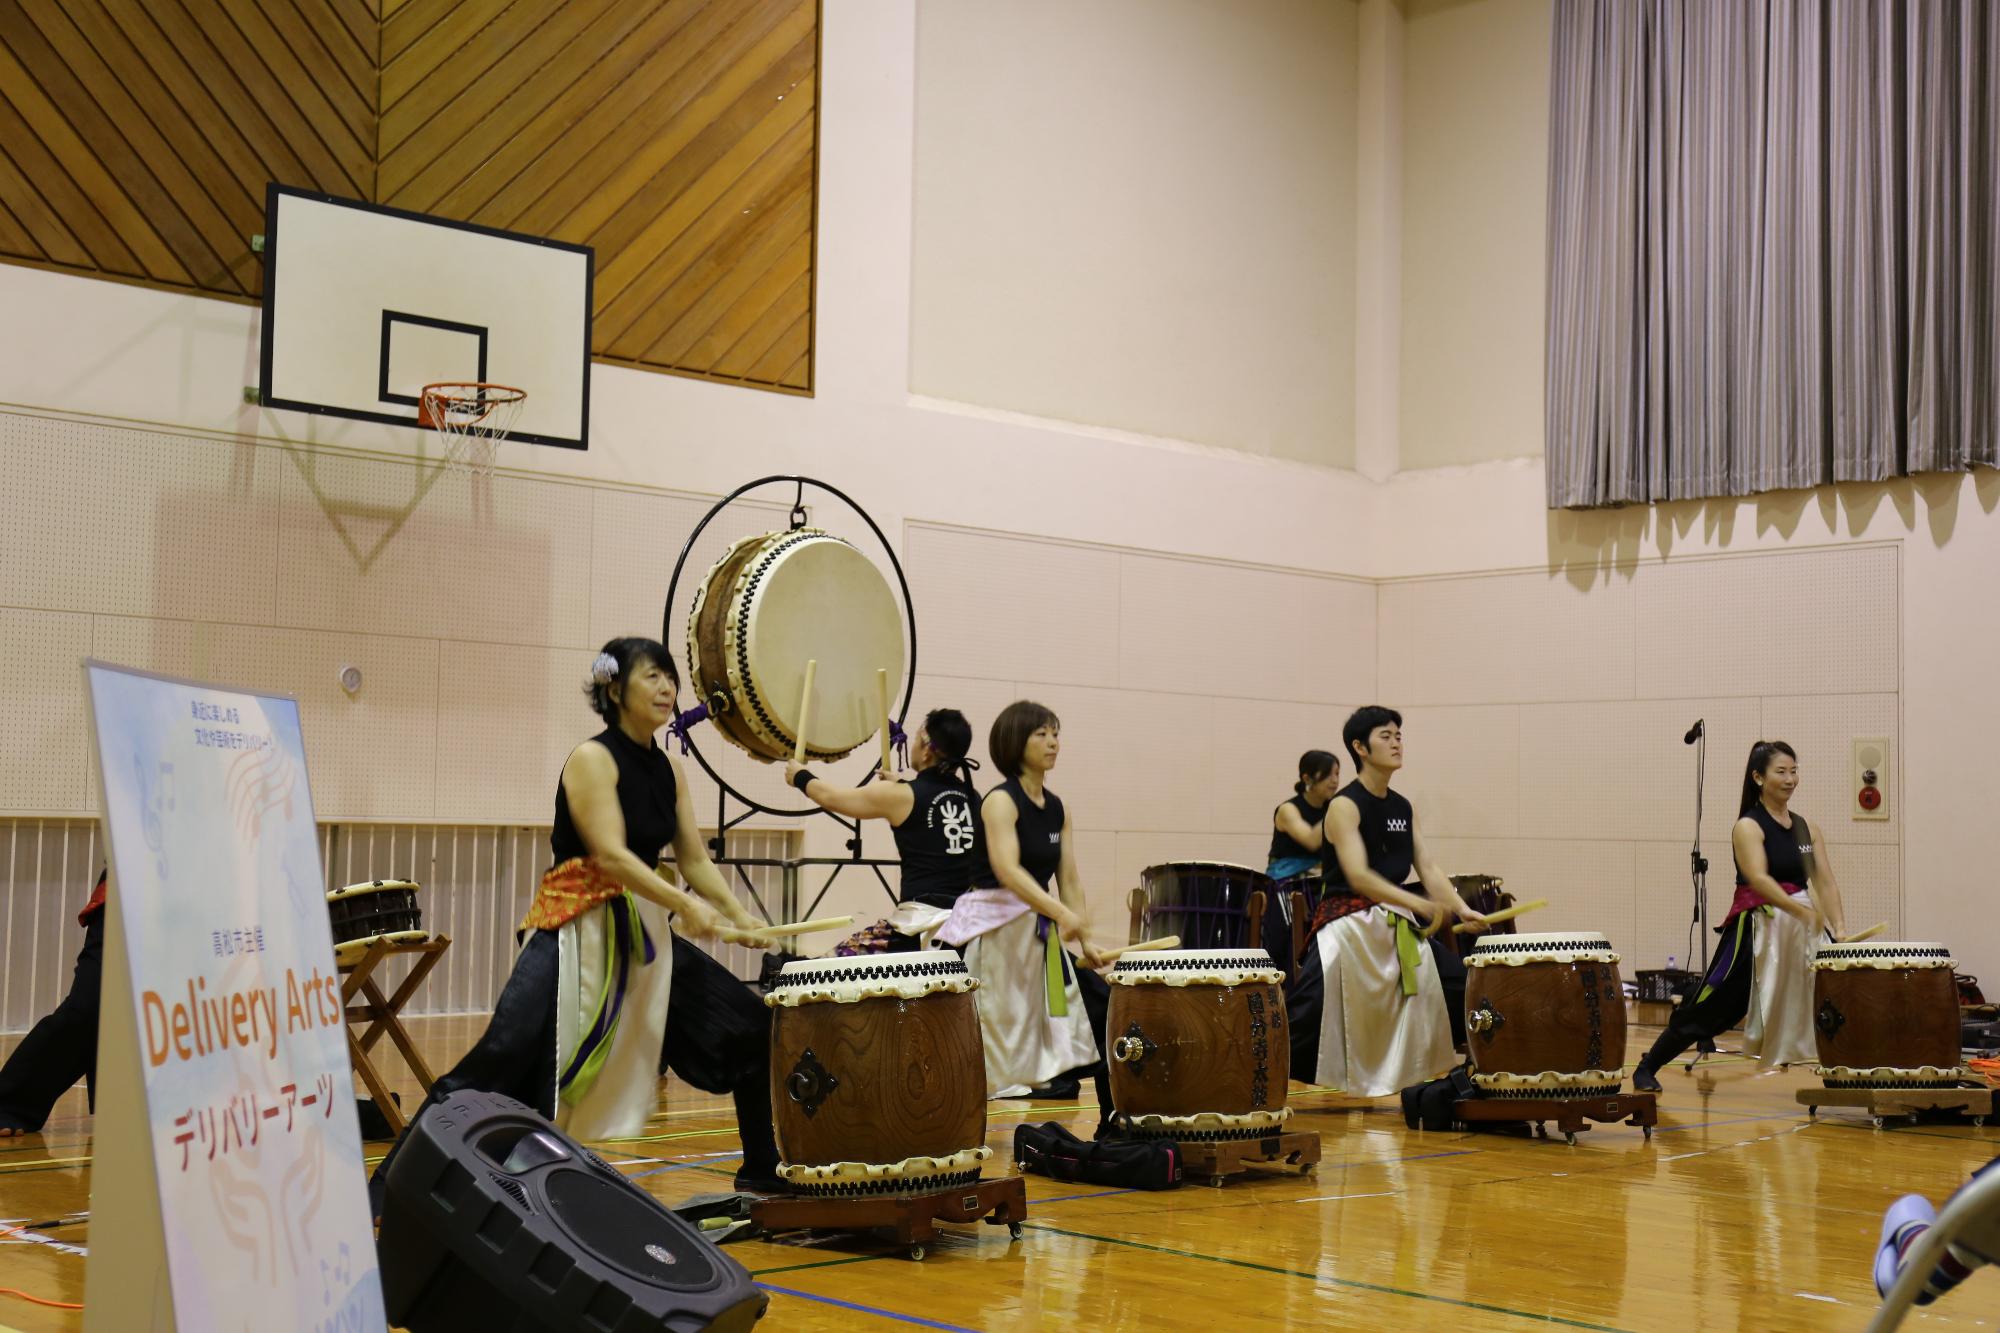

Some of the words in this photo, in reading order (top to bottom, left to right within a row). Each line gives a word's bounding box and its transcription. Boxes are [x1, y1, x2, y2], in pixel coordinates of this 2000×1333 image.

[142, 975, 277, 1067] Delivery
[286, 967, 340, 1034] Arts
[174, 1073, 333, 1172] デリバリーアーツ
